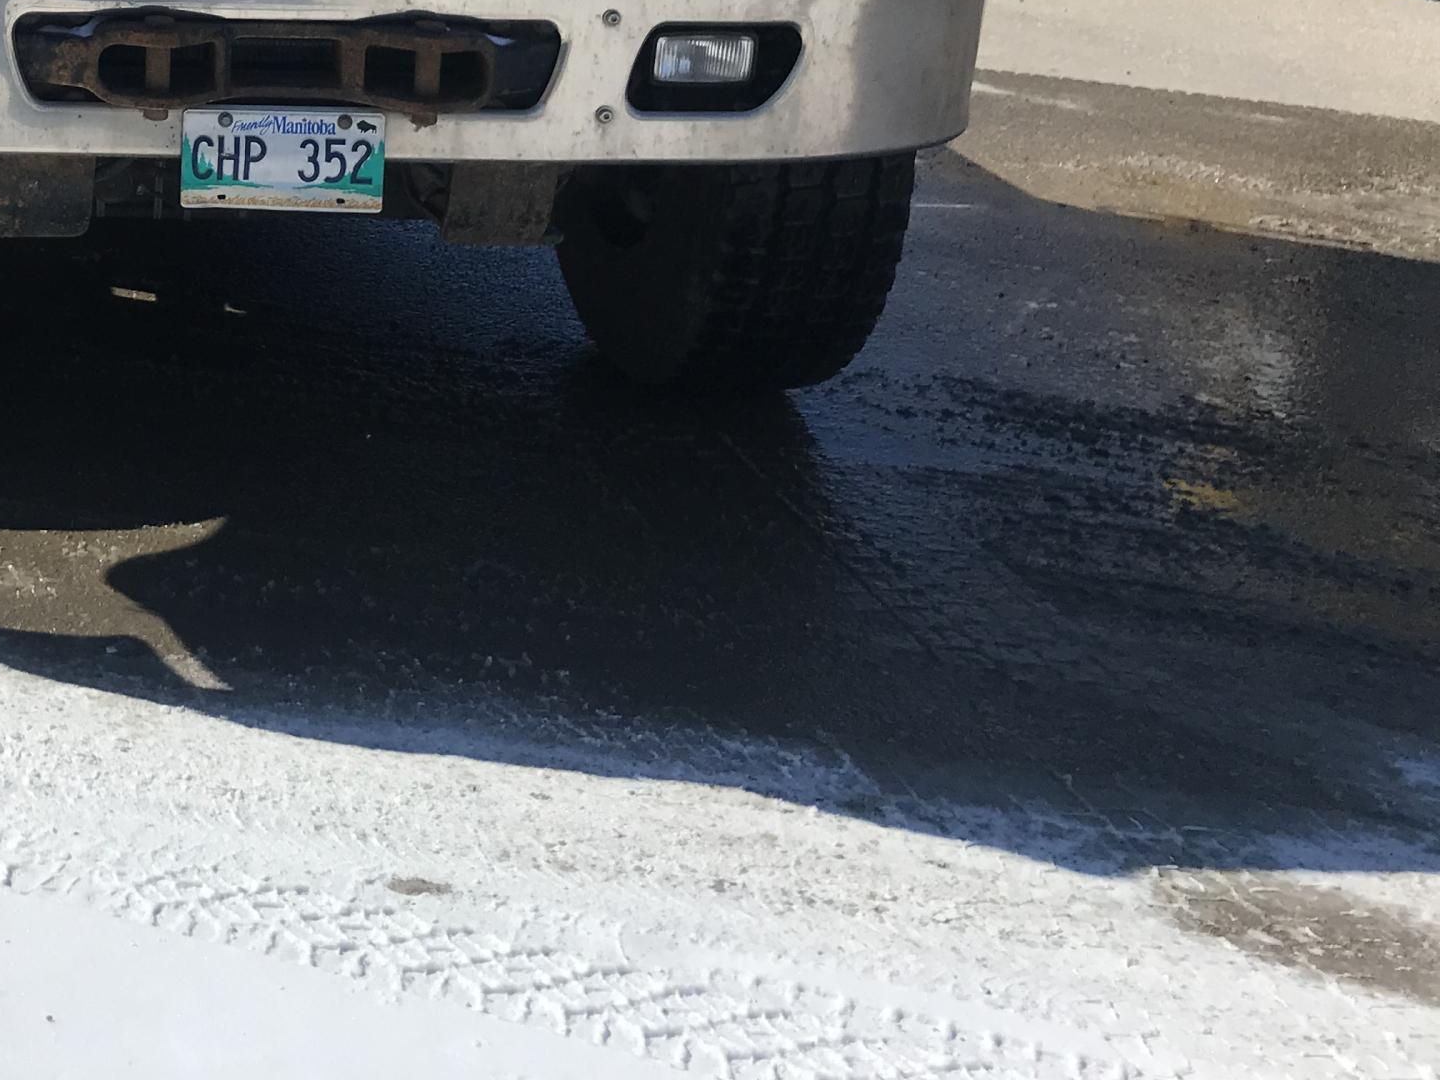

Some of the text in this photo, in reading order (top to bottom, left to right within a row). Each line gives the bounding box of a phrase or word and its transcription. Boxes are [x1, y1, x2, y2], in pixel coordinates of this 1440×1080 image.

[231, 114, 336, 136] Friendly Manitoba
[191, 135, 374, 185] CHP 352
